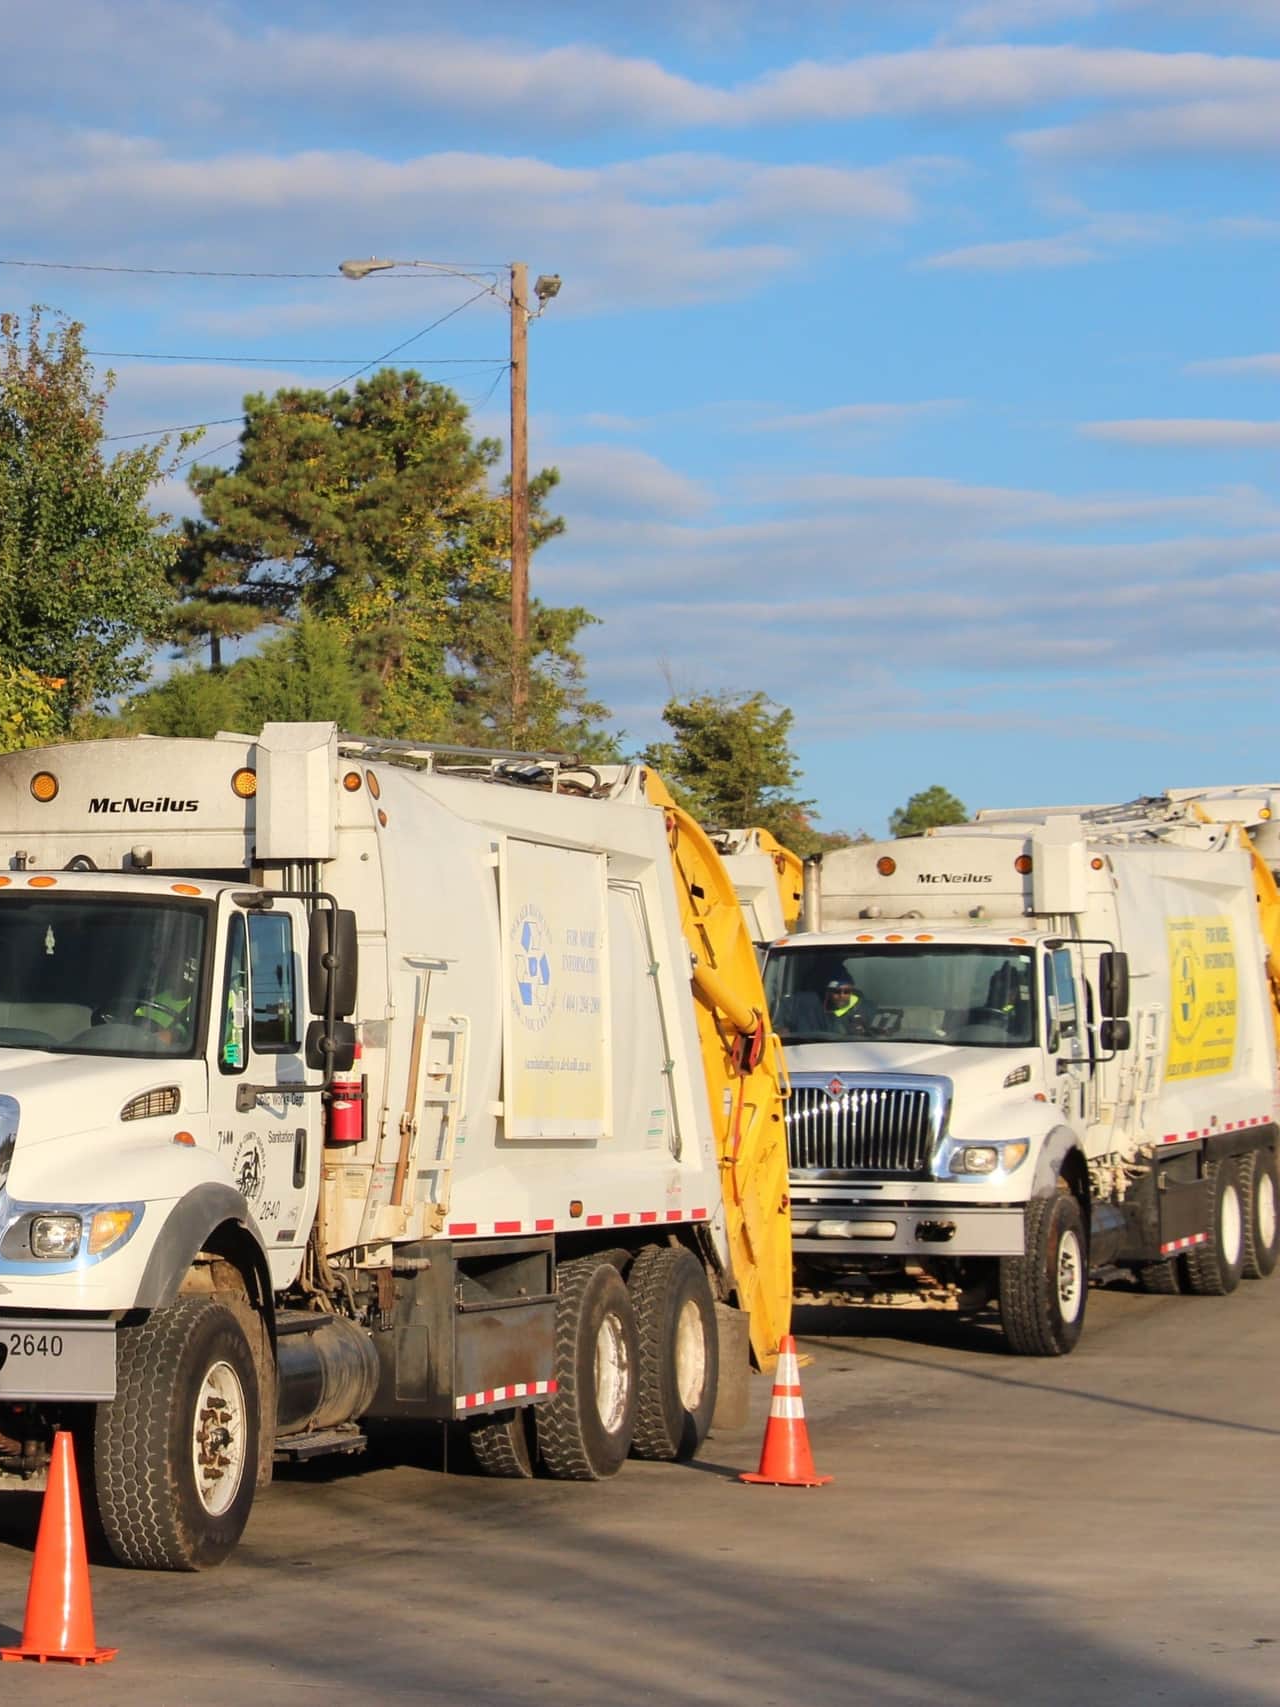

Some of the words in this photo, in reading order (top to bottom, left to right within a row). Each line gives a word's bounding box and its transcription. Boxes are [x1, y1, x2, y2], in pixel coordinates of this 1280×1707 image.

[88, 797, 200, 813] McNeilus
[917, 873, 993, 883] McNeilus
[268, 1130, 294, 1144] Sanitation
[260, 1201, 281, 1220] 2640
[10, 1334, 63, 1356] 2640
